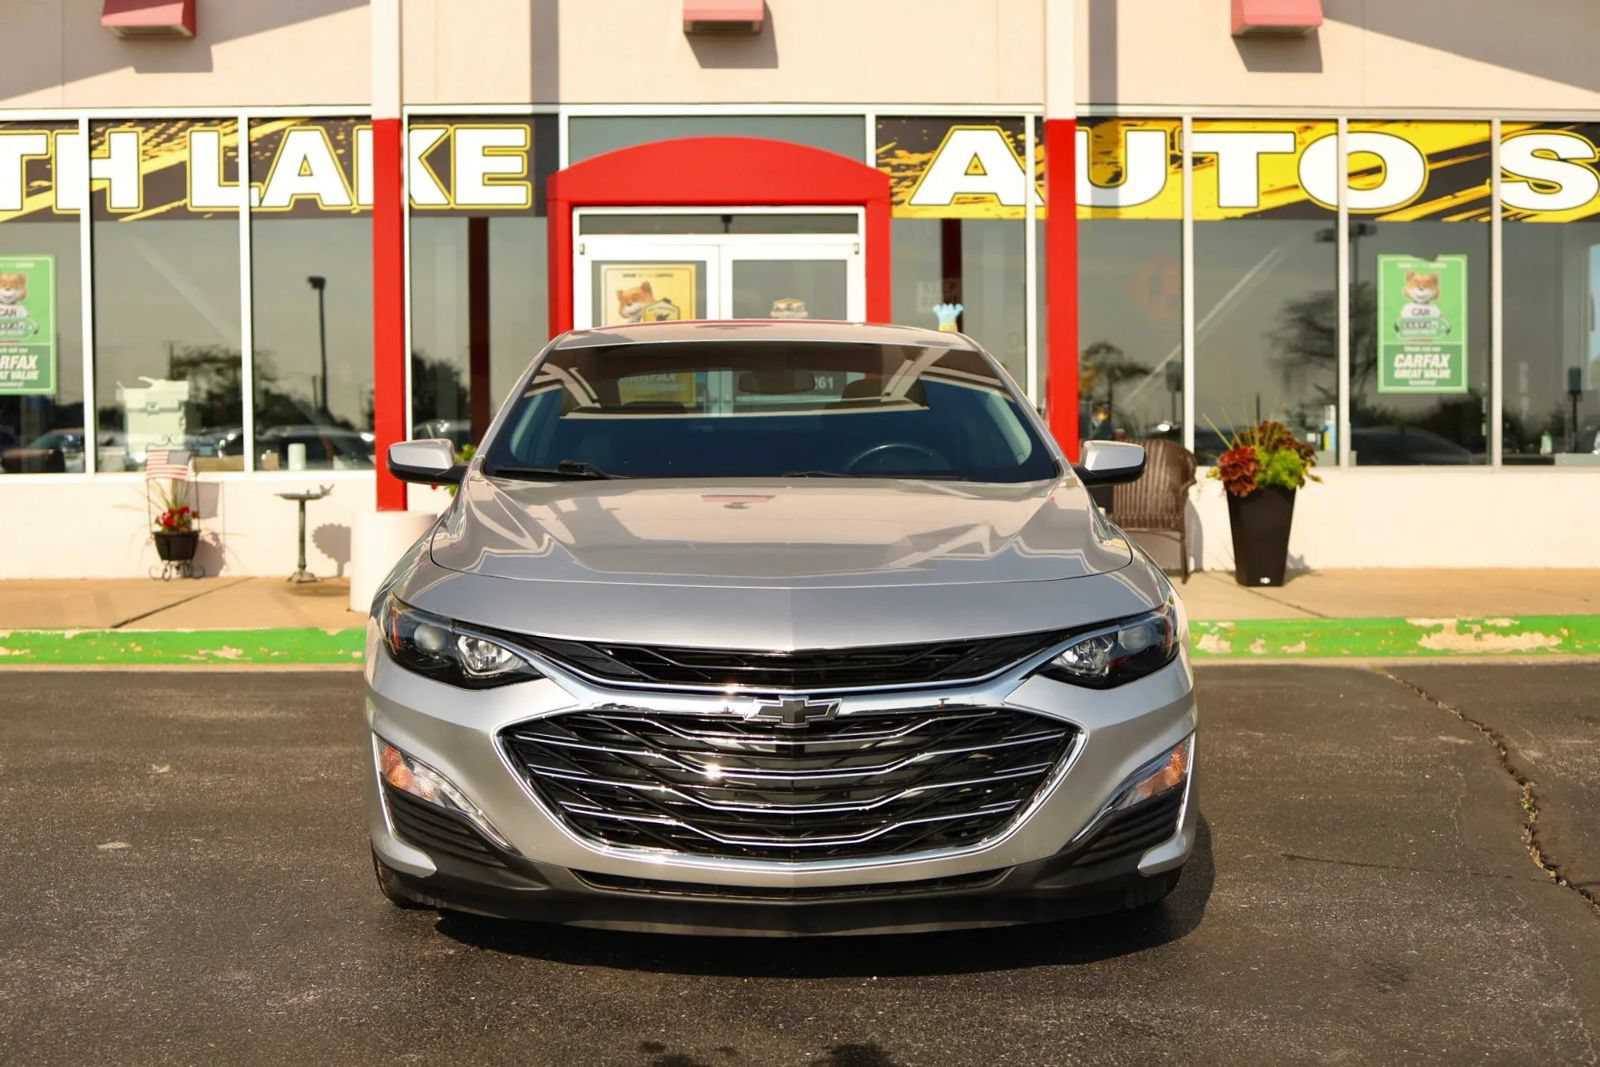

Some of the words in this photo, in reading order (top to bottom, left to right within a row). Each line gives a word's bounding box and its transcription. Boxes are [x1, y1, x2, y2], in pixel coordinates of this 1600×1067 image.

[187, 125, 531, 211] LAKE
[908, 125, 1428, 211] AUTO
[1394, 353, 1451, 368] CARFAX
